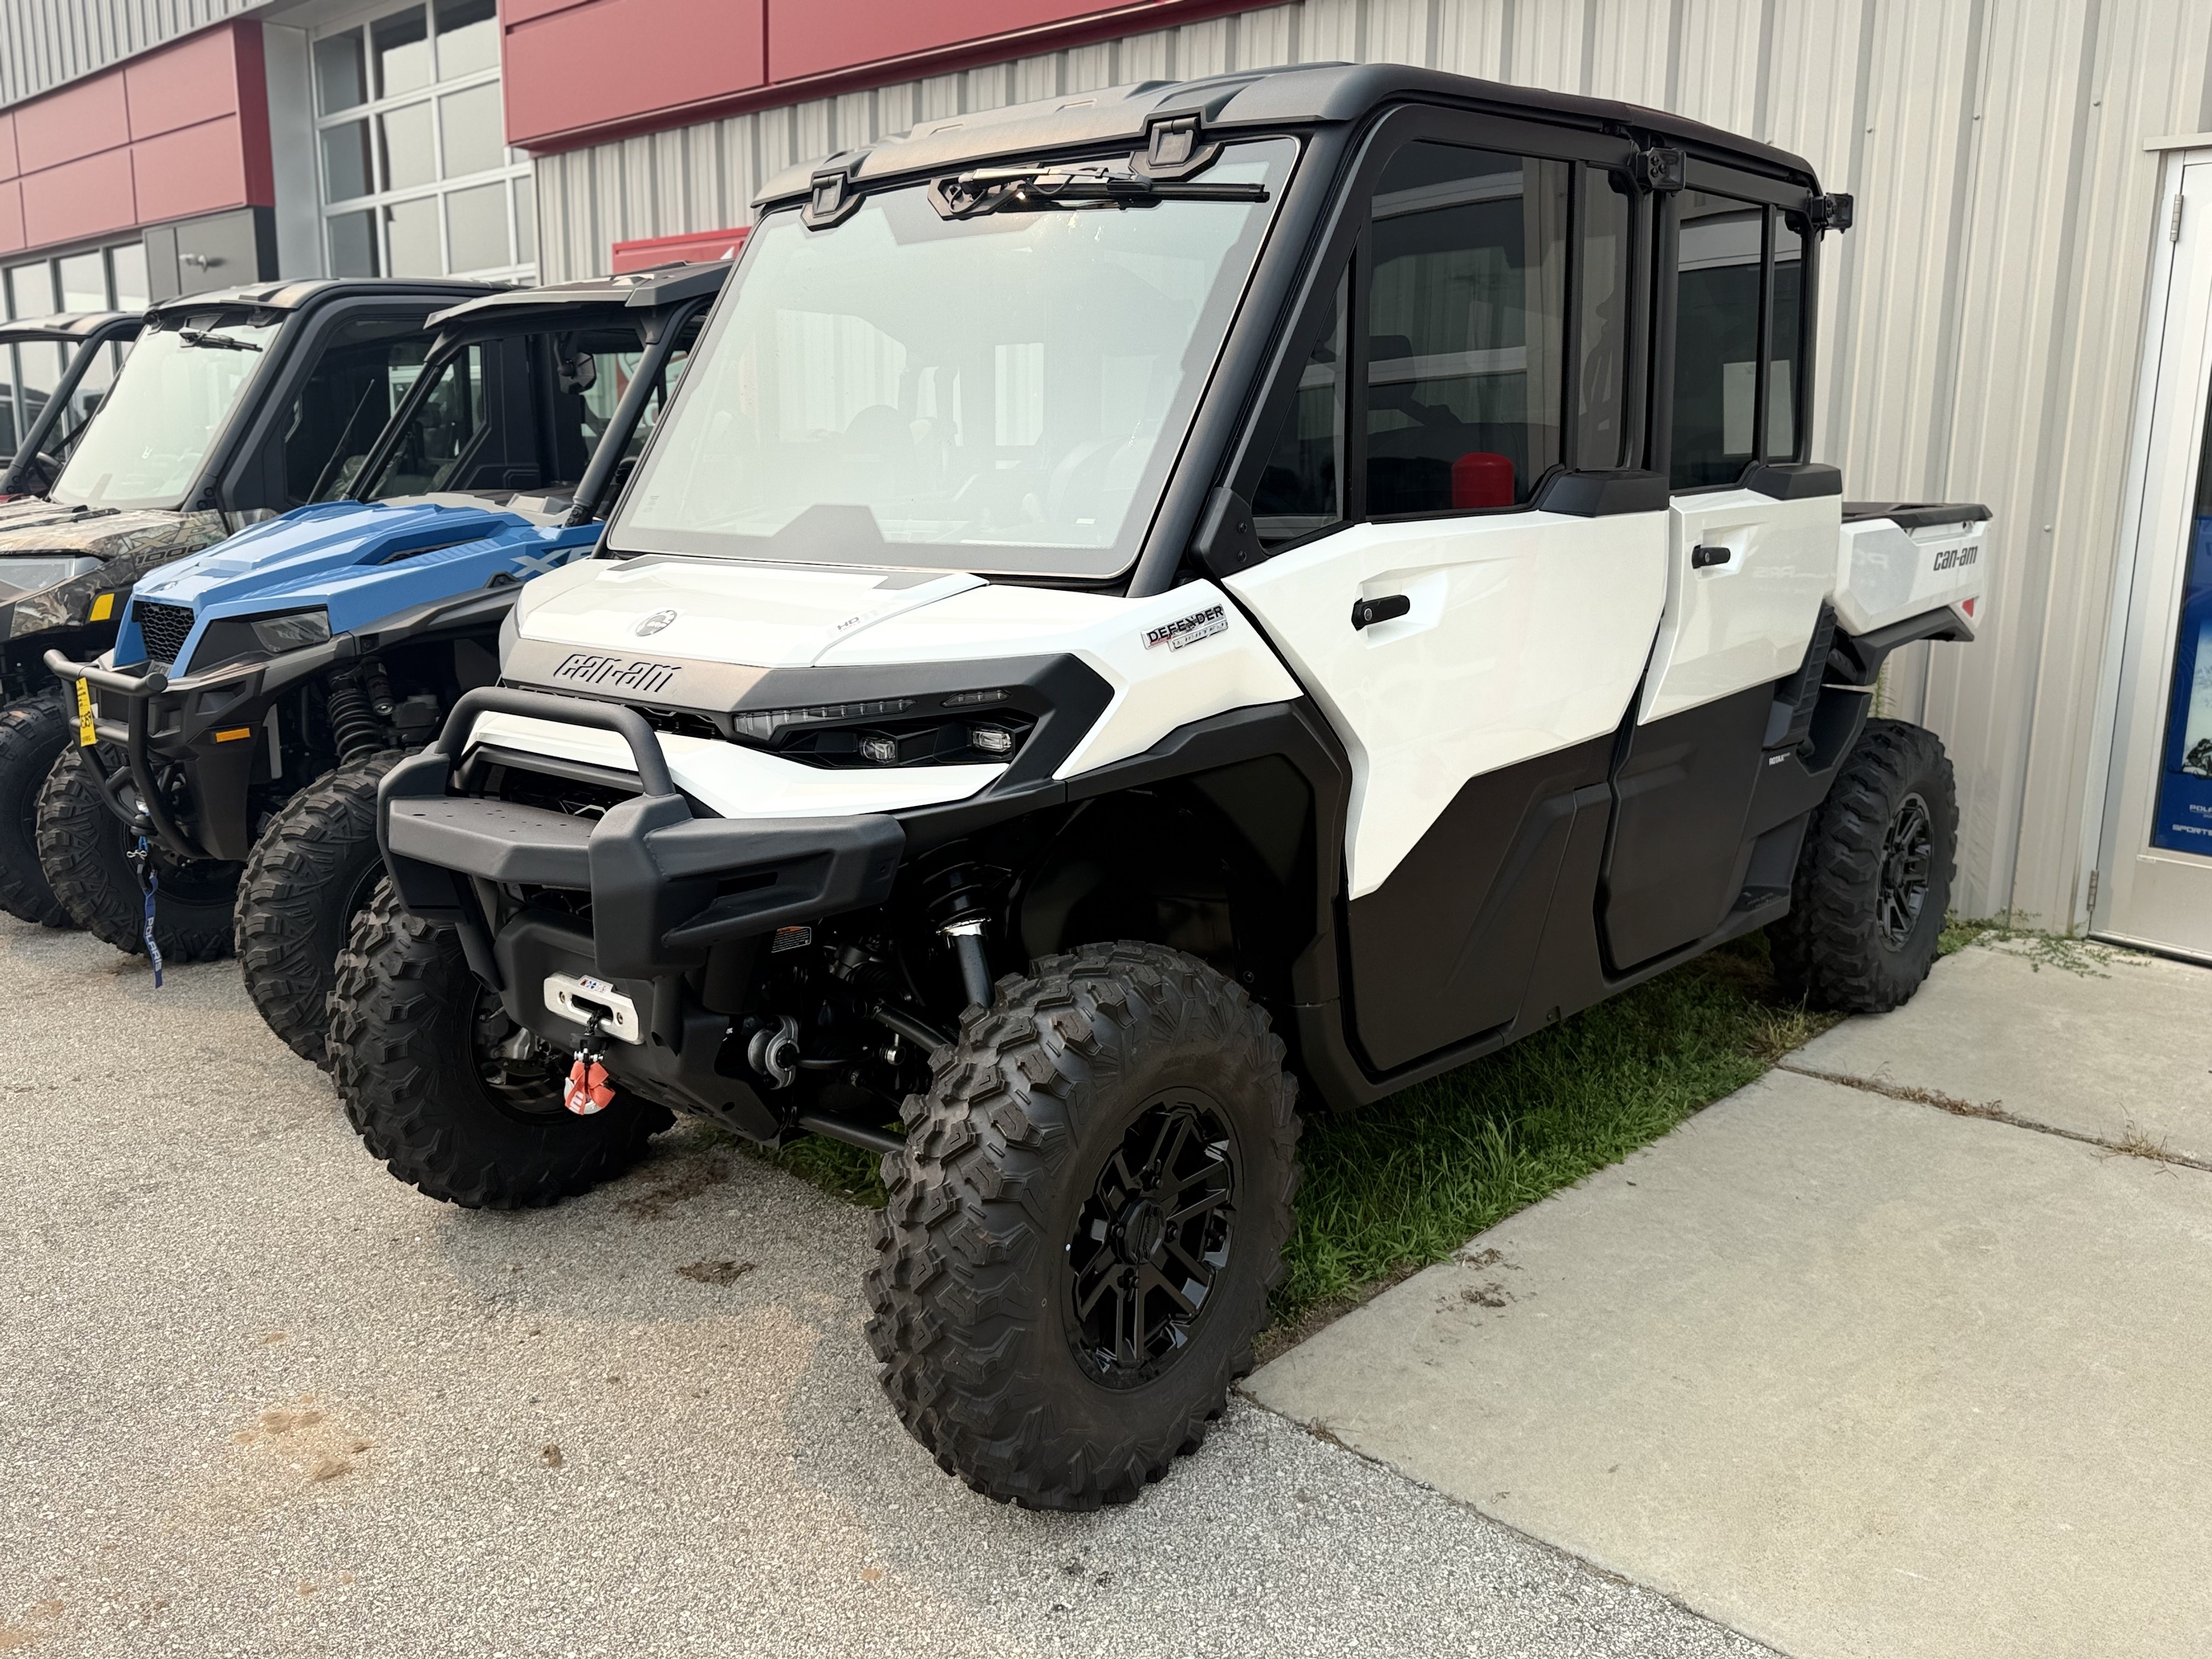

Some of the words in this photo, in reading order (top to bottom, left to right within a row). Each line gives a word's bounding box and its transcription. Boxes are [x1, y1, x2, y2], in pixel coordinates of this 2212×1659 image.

[136, 543, 207, 566] 1000
[1933, 546, 1978, 571] can-am
[1147, 605, 1224, 643] DEFENDER
[553, 653, 682, 693] can-am
[145, 917, 163, 972] POLARIS
